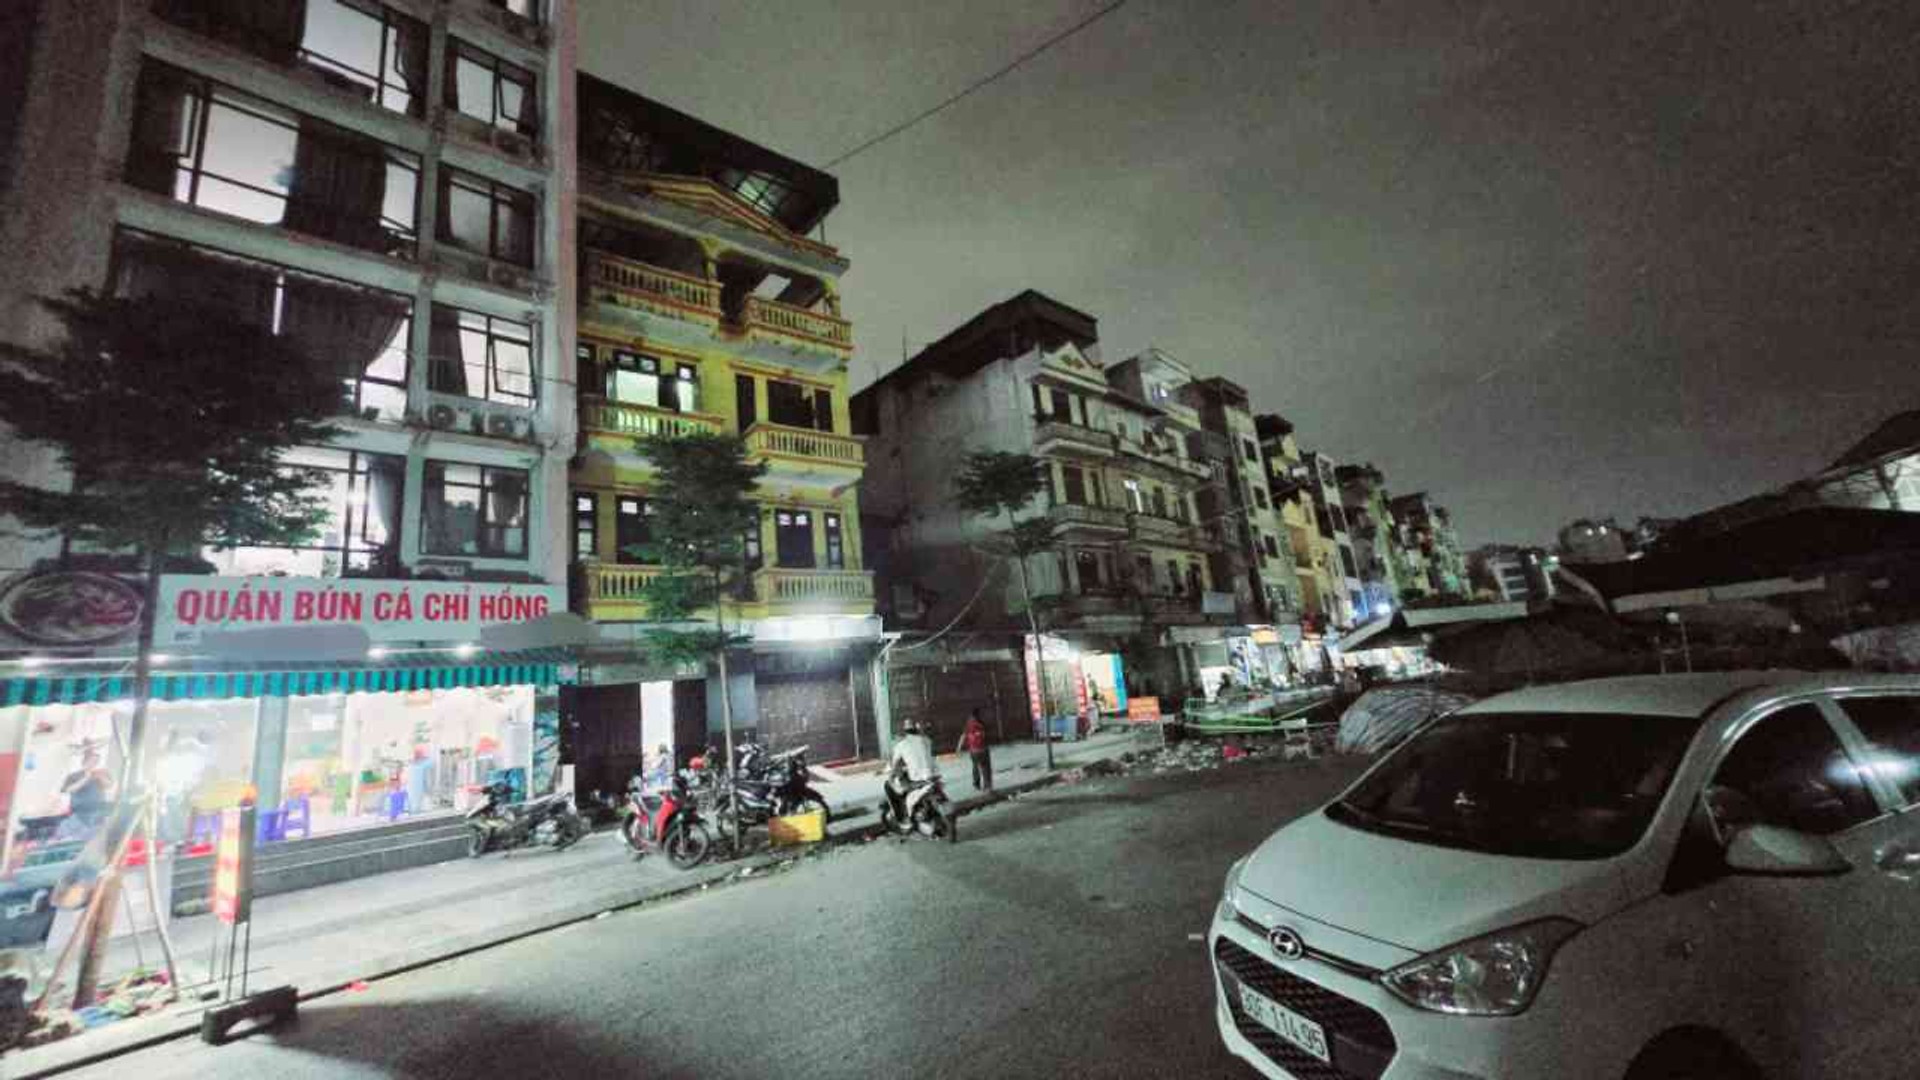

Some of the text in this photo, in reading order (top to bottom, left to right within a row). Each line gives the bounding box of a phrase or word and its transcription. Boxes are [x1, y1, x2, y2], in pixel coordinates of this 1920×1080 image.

[177, 583, 282, 625] QUÁN
[294, 585, 362, 622] BÚN
[373, 587, 413, 621] CÁ
